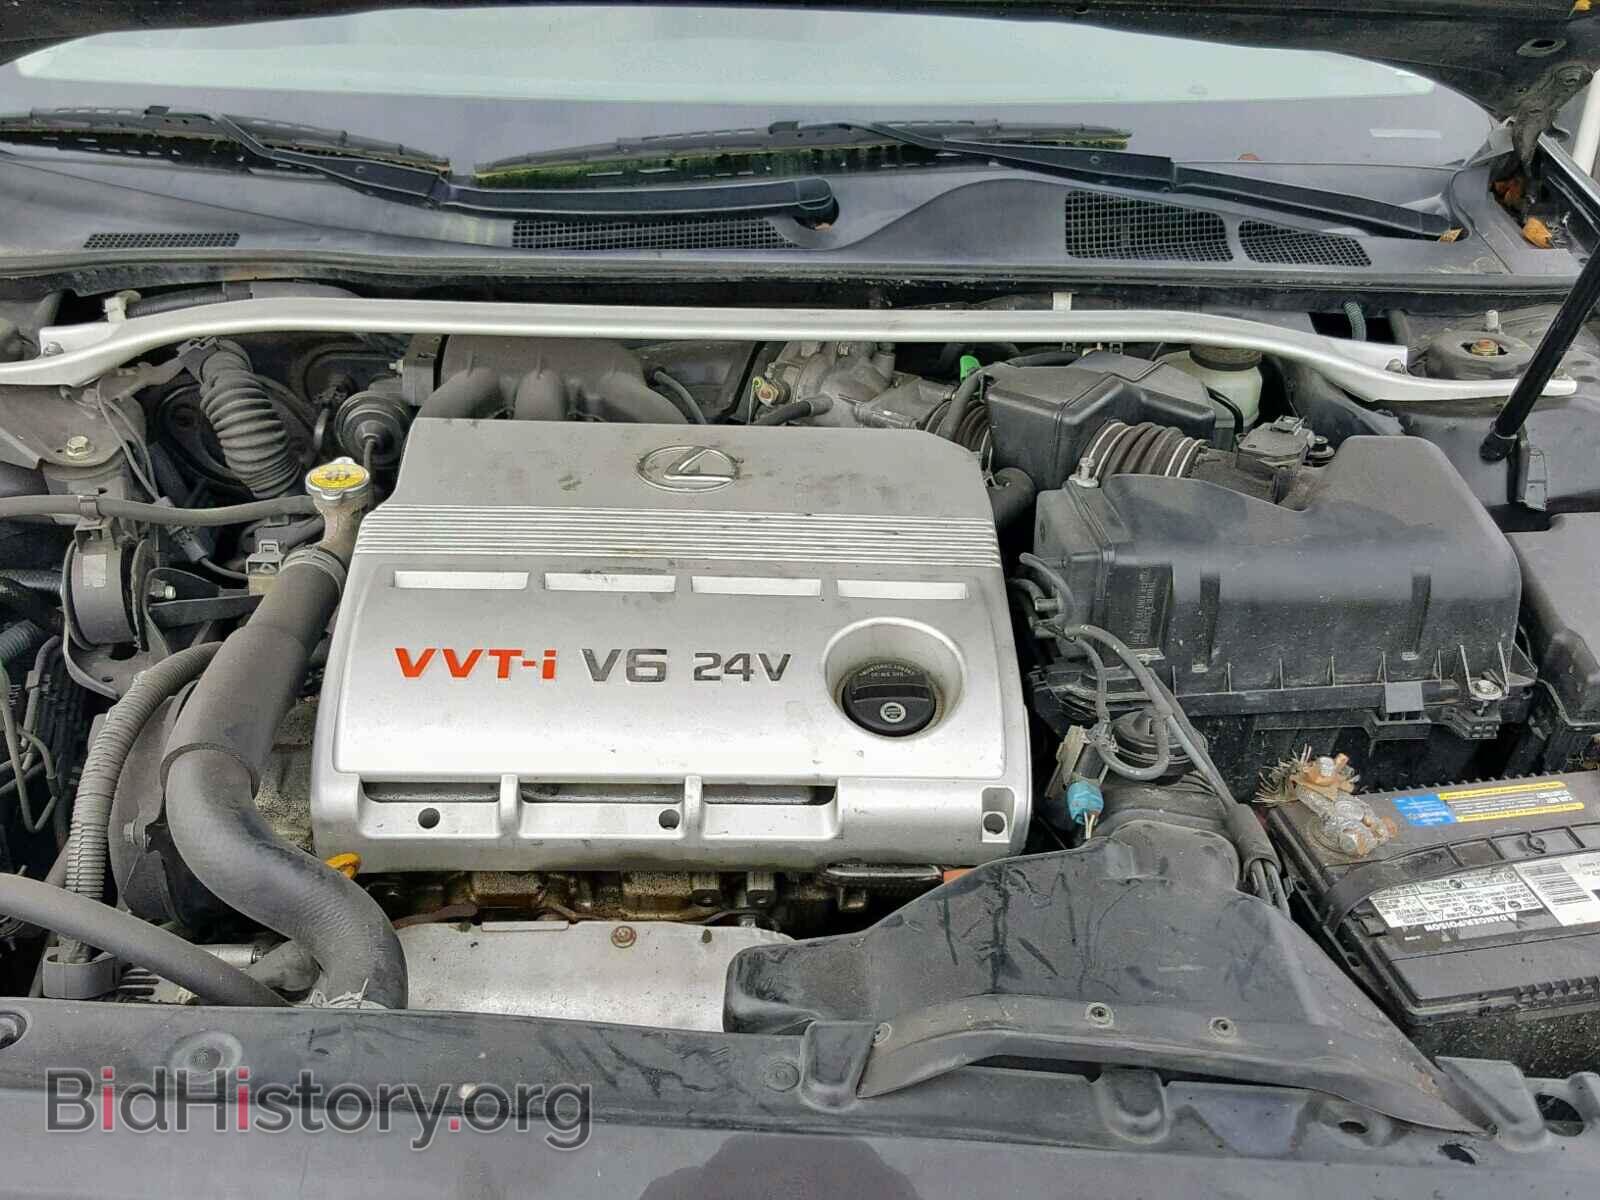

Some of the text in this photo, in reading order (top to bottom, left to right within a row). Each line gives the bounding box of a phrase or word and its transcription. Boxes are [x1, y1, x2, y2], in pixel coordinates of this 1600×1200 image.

[394, 648, 792, 683] VVT-i V6 24V
